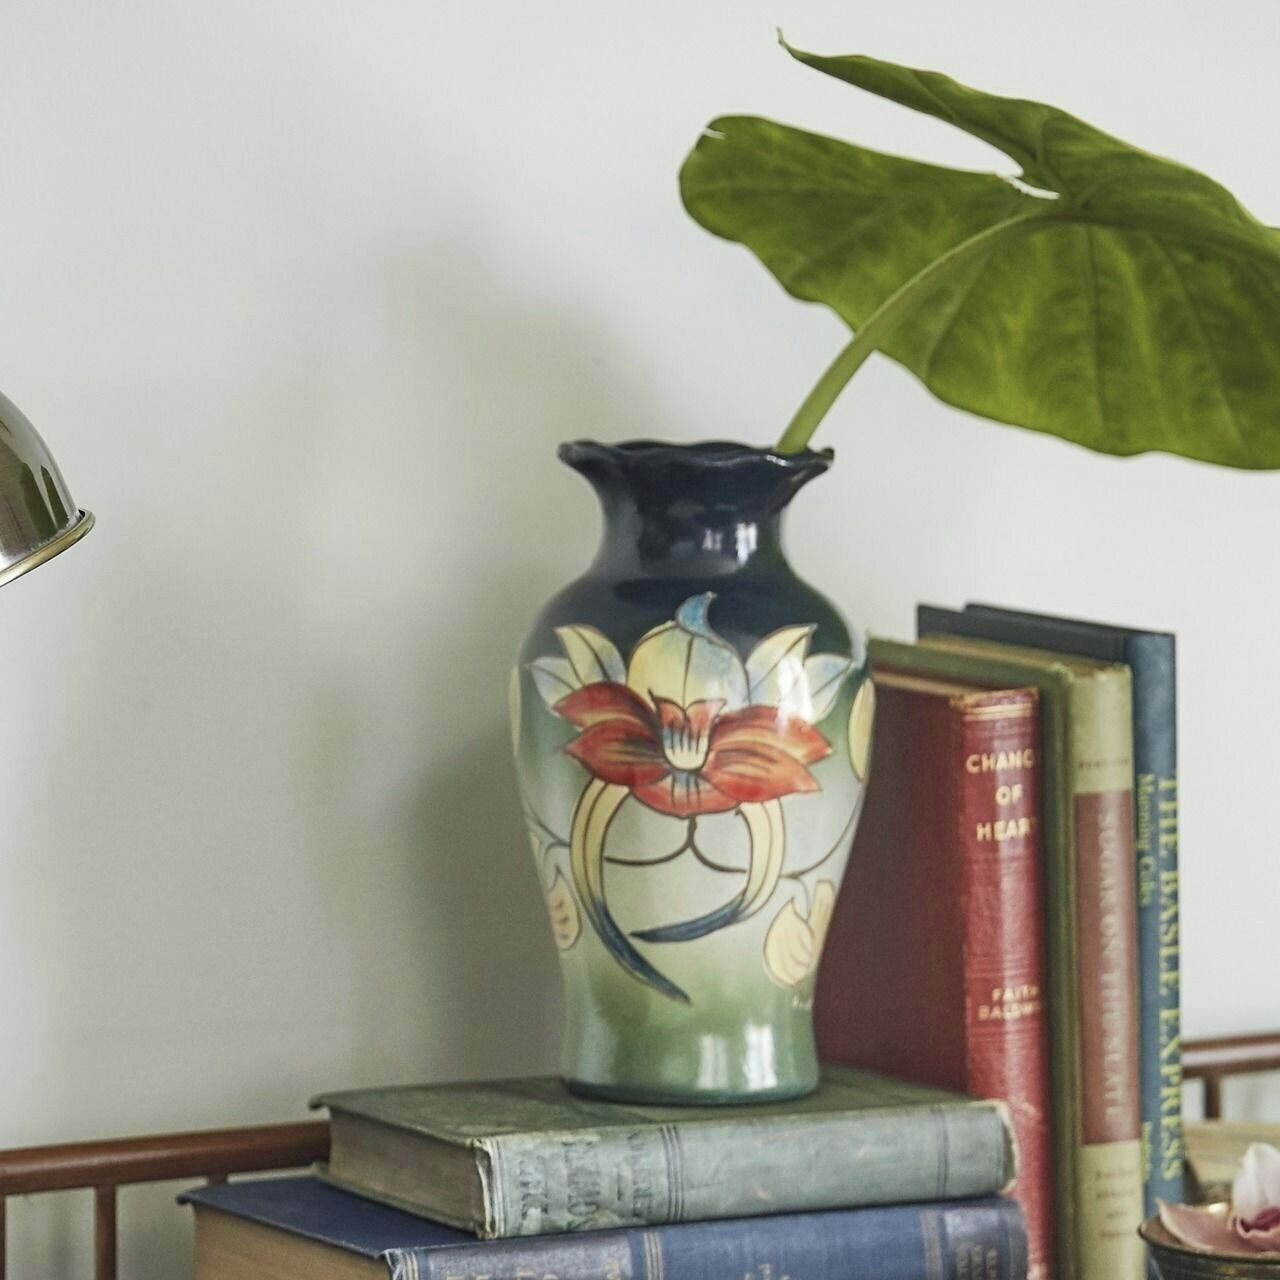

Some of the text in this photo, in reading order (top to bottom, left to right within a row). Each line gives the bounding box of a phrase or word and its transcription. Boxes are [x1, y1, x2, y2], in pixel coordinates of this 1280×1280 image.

[966, 749, 1034, 774] CHANG
[995, 784, 1023, 806] OF
[976, 817, 1036, 842] HEAR
[1158, 772, 1182, 1181] THE BASLE EXPRESS
